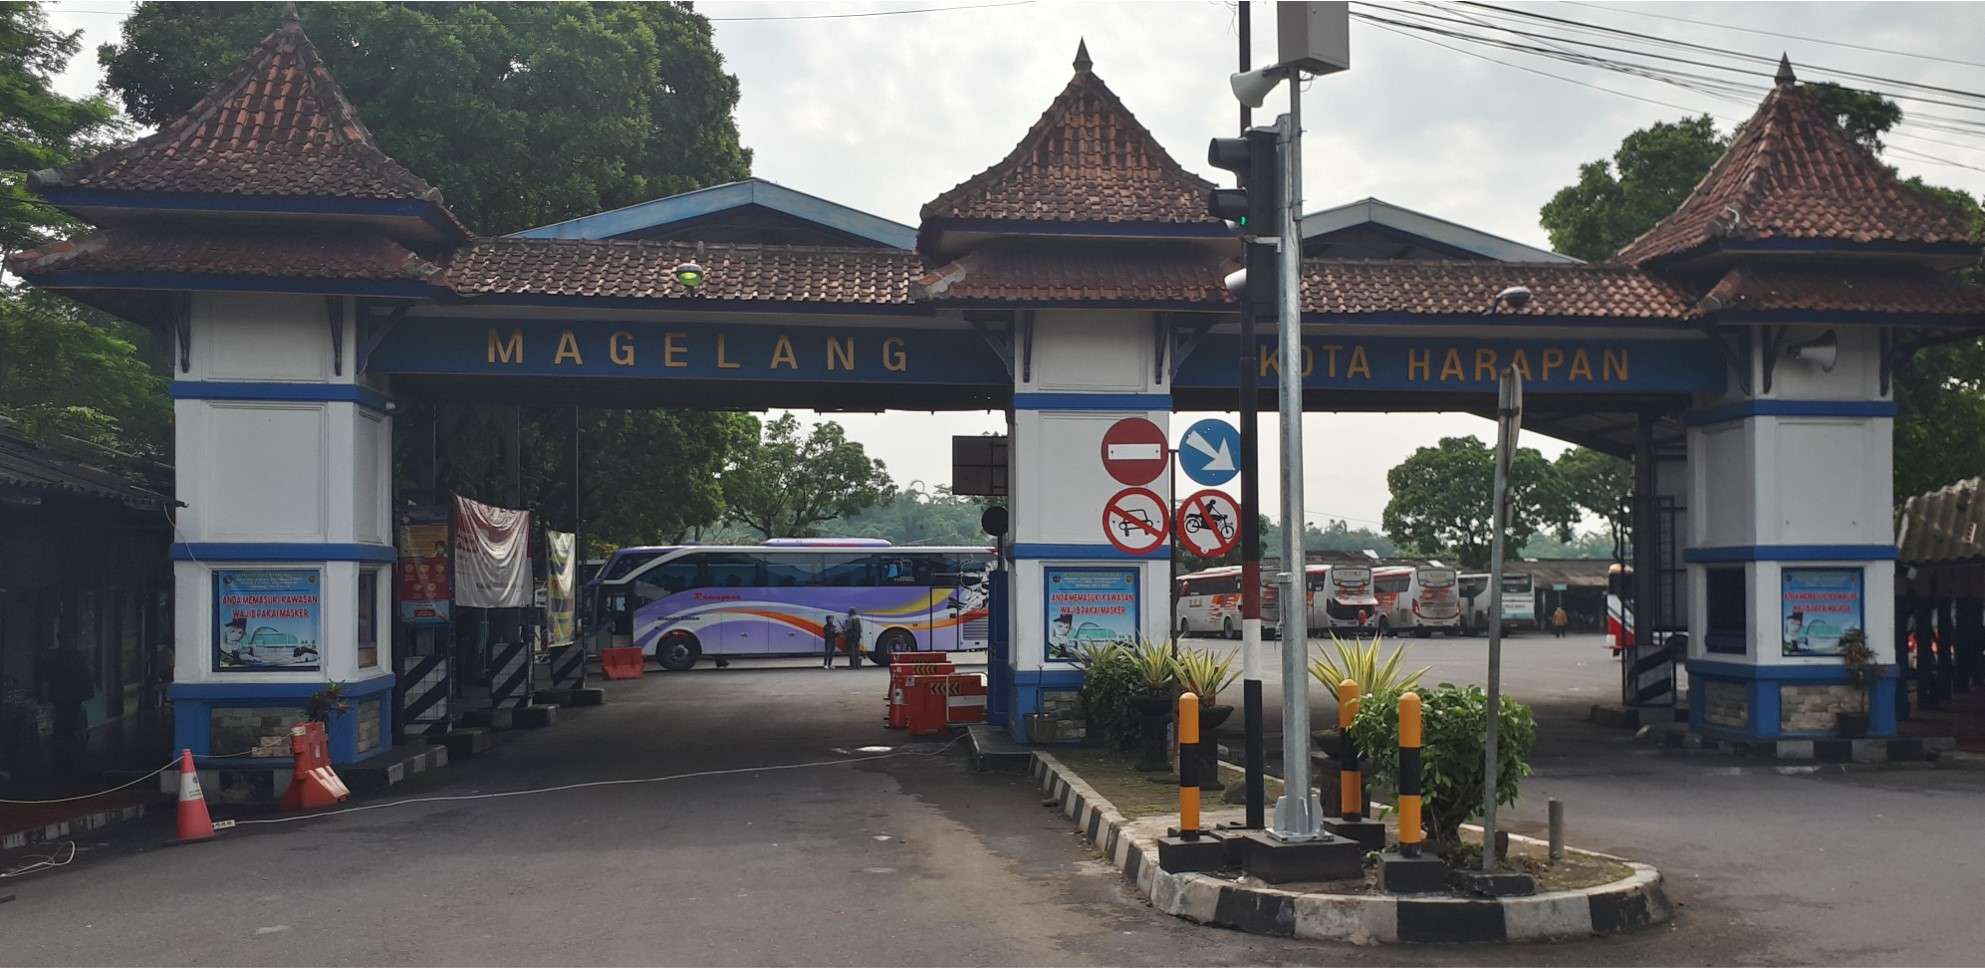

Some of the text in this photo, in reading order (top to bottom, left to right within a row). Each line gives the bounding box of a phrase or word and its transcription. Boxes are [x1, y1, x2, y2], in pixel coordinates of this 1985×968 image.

[487, 328, 908, 373] MAGELANG
[1408, 348, 1630, 383] HARAPAN
[223, 594, 319, 604] ANDA MEMASUKI KAWASAN
[233, 609, 309, 618] WAJIB PAKAI MASKER
